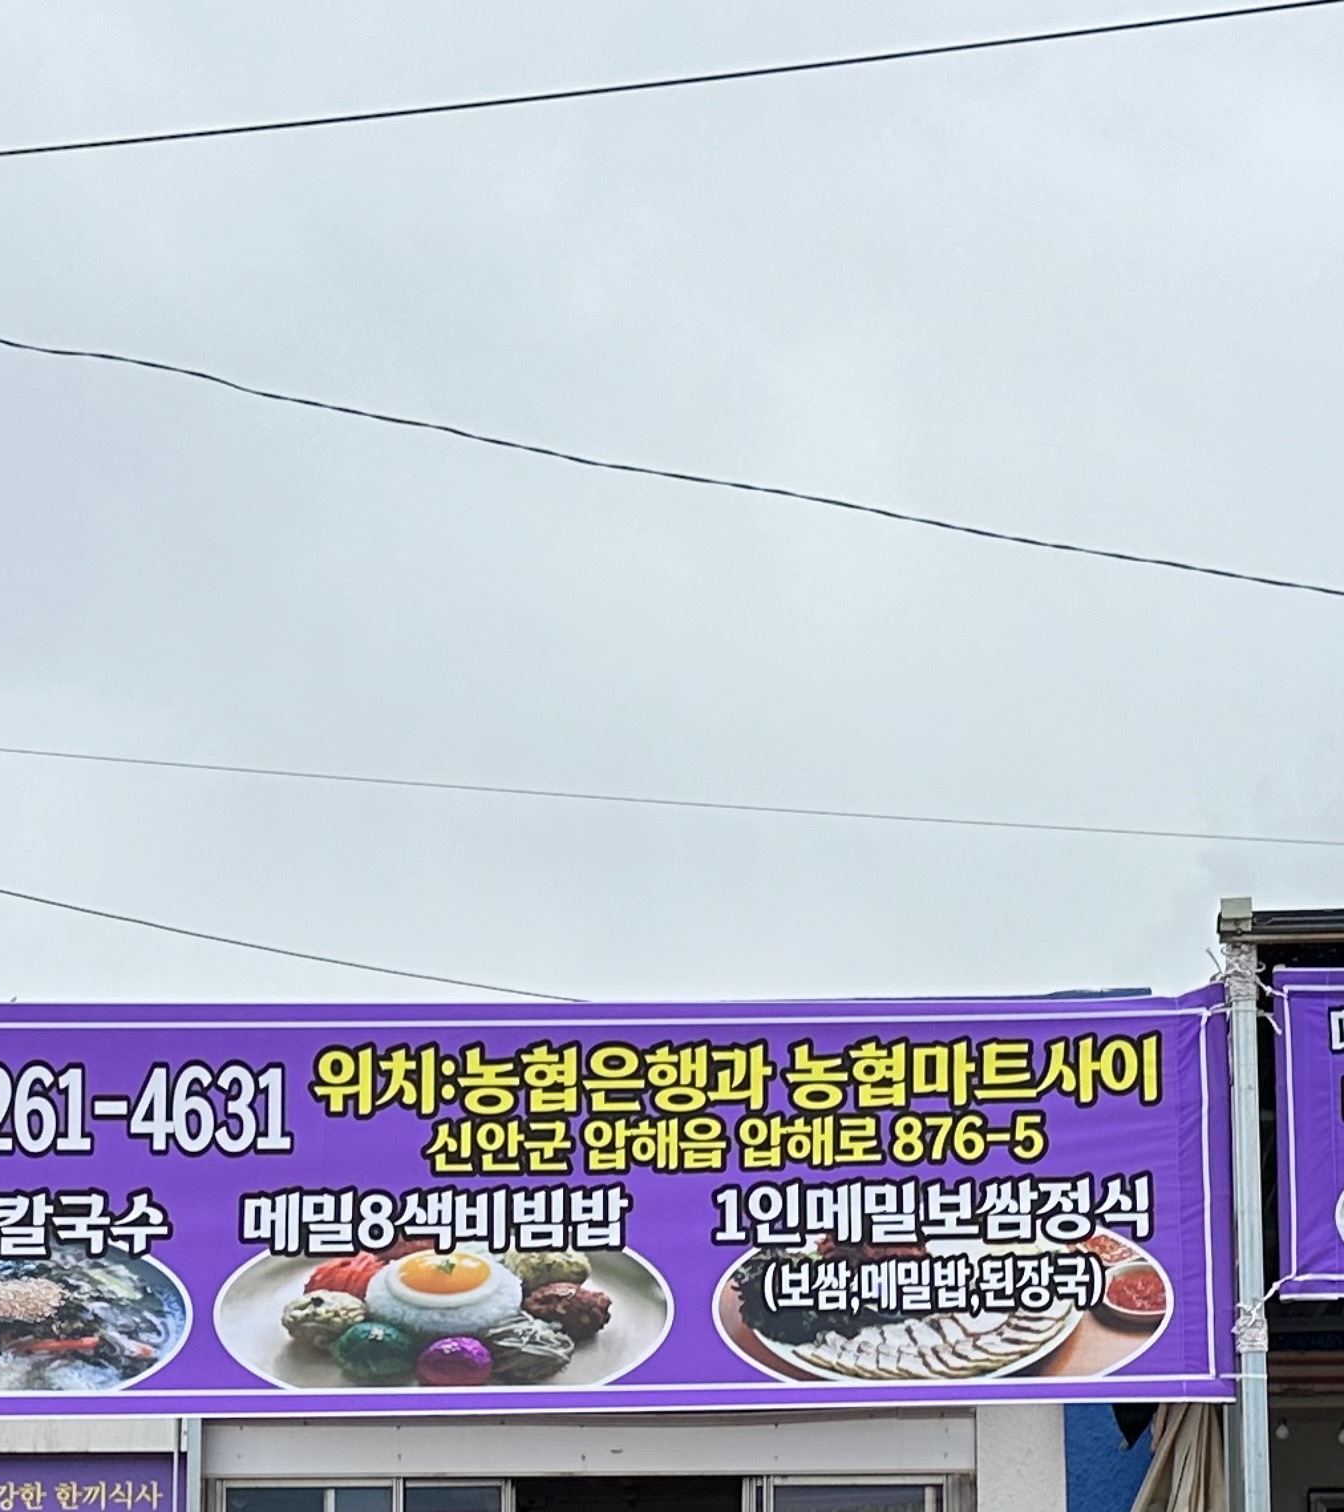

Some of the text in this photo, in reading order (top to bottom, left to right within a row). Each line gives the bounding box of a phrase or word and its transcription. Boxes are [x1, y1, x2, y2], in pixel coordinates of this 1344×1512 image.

[312, 1035, 1160, 1116] 위치:농협은행과 농협마트사이
[427, 1115, 1046, 1173] 신안군 압해읍 압해로 876-5
[242, 1185, 628, 1254] 메밀8색비빔밥
[712, 1174, 1153, 1244] 1인메밀보쌈정식
[54, 1481, 163, 1510] 한끼식사
